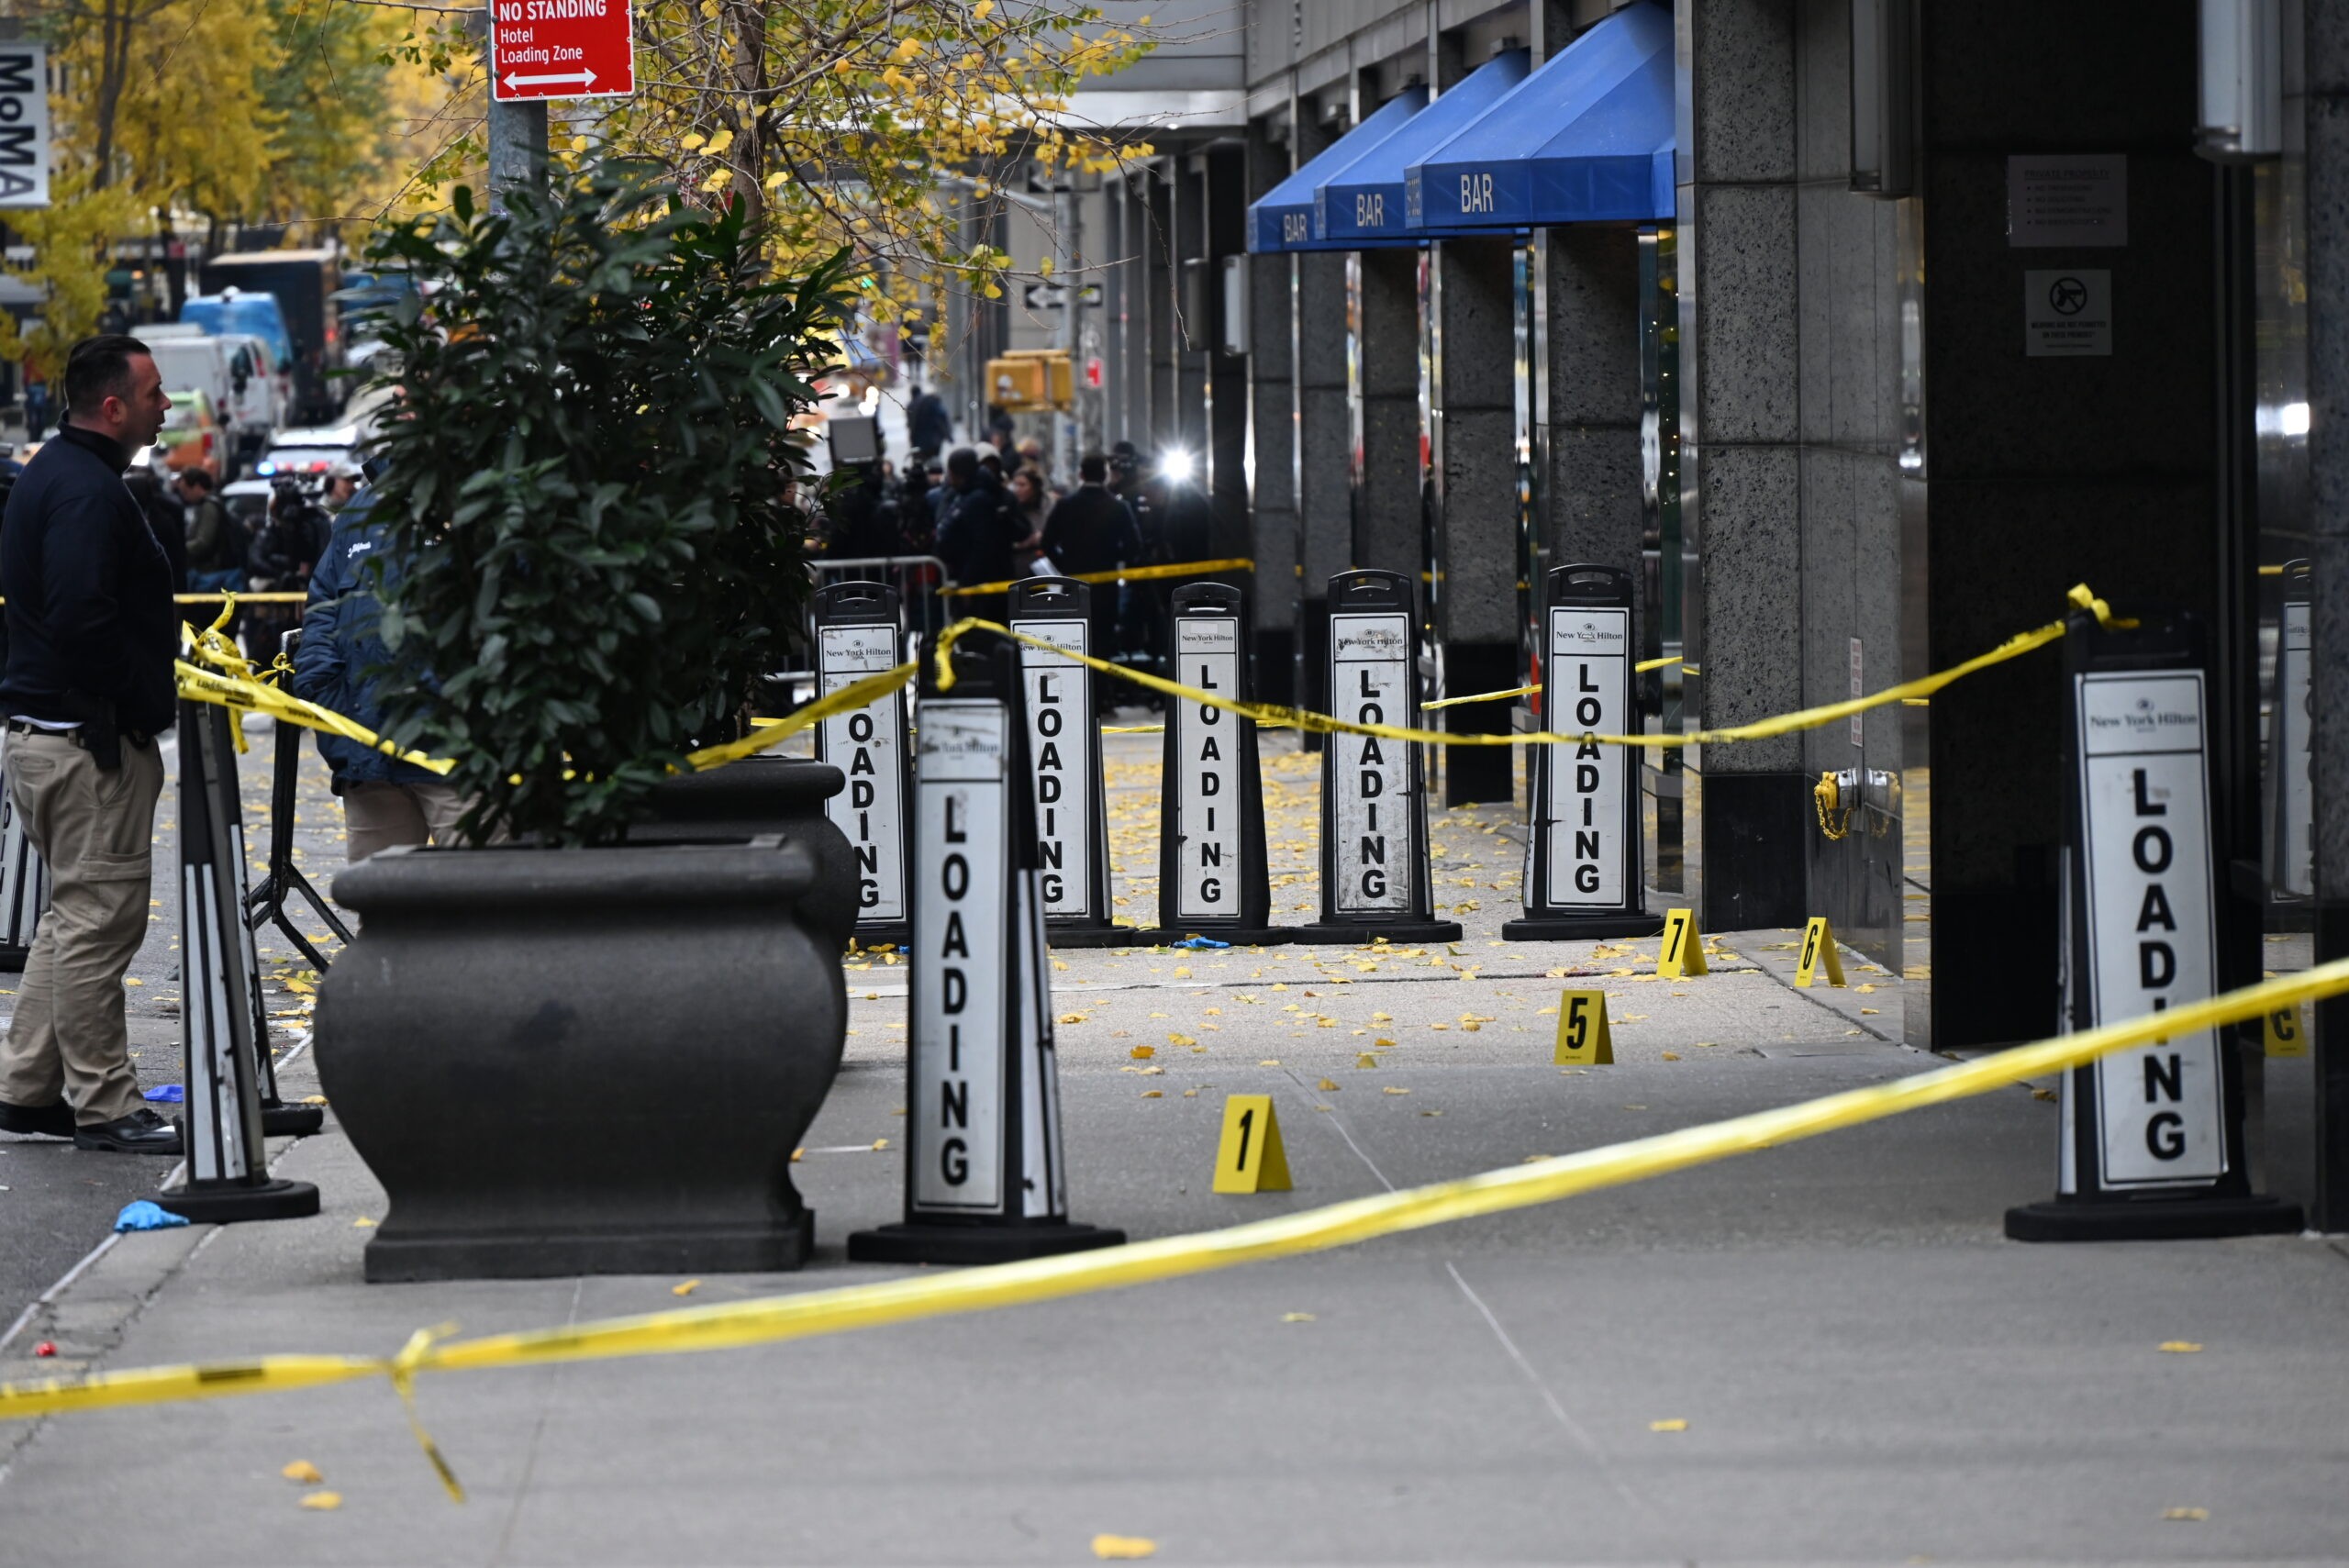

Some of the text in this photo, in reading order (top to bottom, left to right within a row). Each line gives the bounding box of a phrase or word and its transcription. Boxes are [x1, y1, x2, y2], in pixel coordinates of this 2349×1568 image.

[500, 0, 607, 21] NO STANDING
[500, 27, 533, 43] Hotel
[501, 46, 584, 64] Loading Zone
[0, 54, 36, 199] MoMA
[1357, 194, 1384, 227] BAR
[1461, 173, 1493, 213] BAR
[1285, 215, 1308, 241] BAR
[2091, 712, 2197, 727] New York Hilton
[848, 681, 879, 908] OADING
[1038, 675, 1063, 903] LOADING
[1199, 665, 1221, 904] LOADING
[1359, 670, 1386, 898] LOADING
[1575, 664, 1601, 894] LOADING
[1668, 918, 1684, 962] 7
[1802, 924, 1818, 970] 6
[941, 795, 970, 1186] LOADING
[1566, 997, 1588, 1050] 5
[1237, 1109, 1253, 1171] 1
